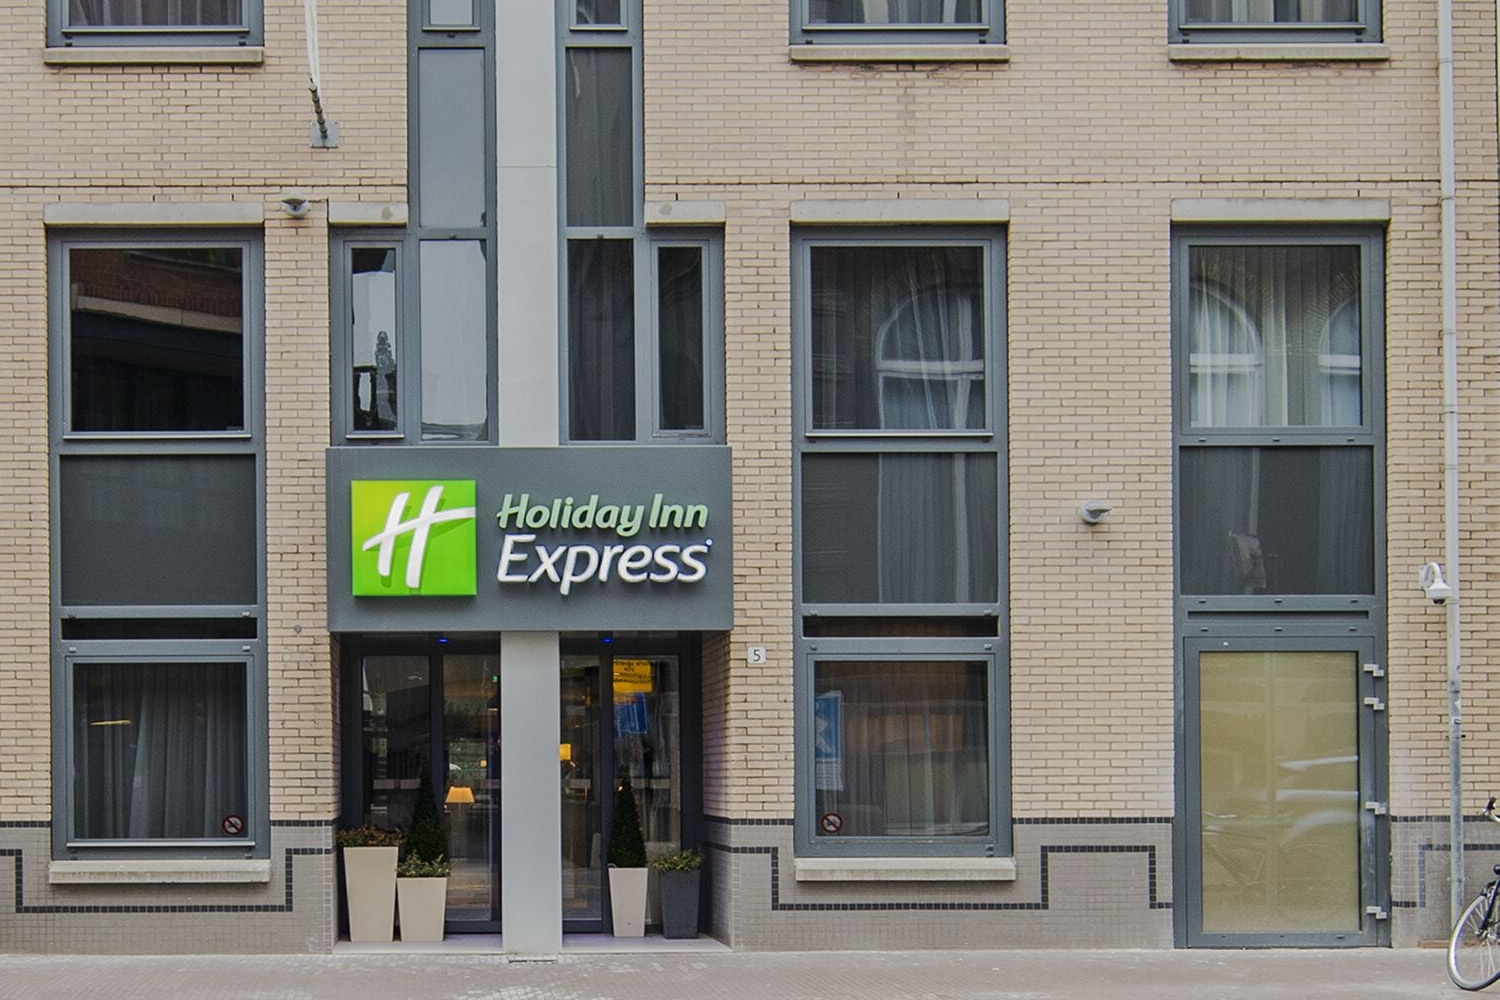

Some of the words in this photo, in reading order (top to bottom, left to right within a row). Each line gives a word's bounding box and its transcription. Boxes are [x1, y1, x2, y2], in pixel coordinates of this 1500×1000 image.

[497, 493, 645, 537] Holiday
[649, 493, 709, 529] Inn
[497, 533, 711, 596] Express
[753, 648, 761, 662] 5
